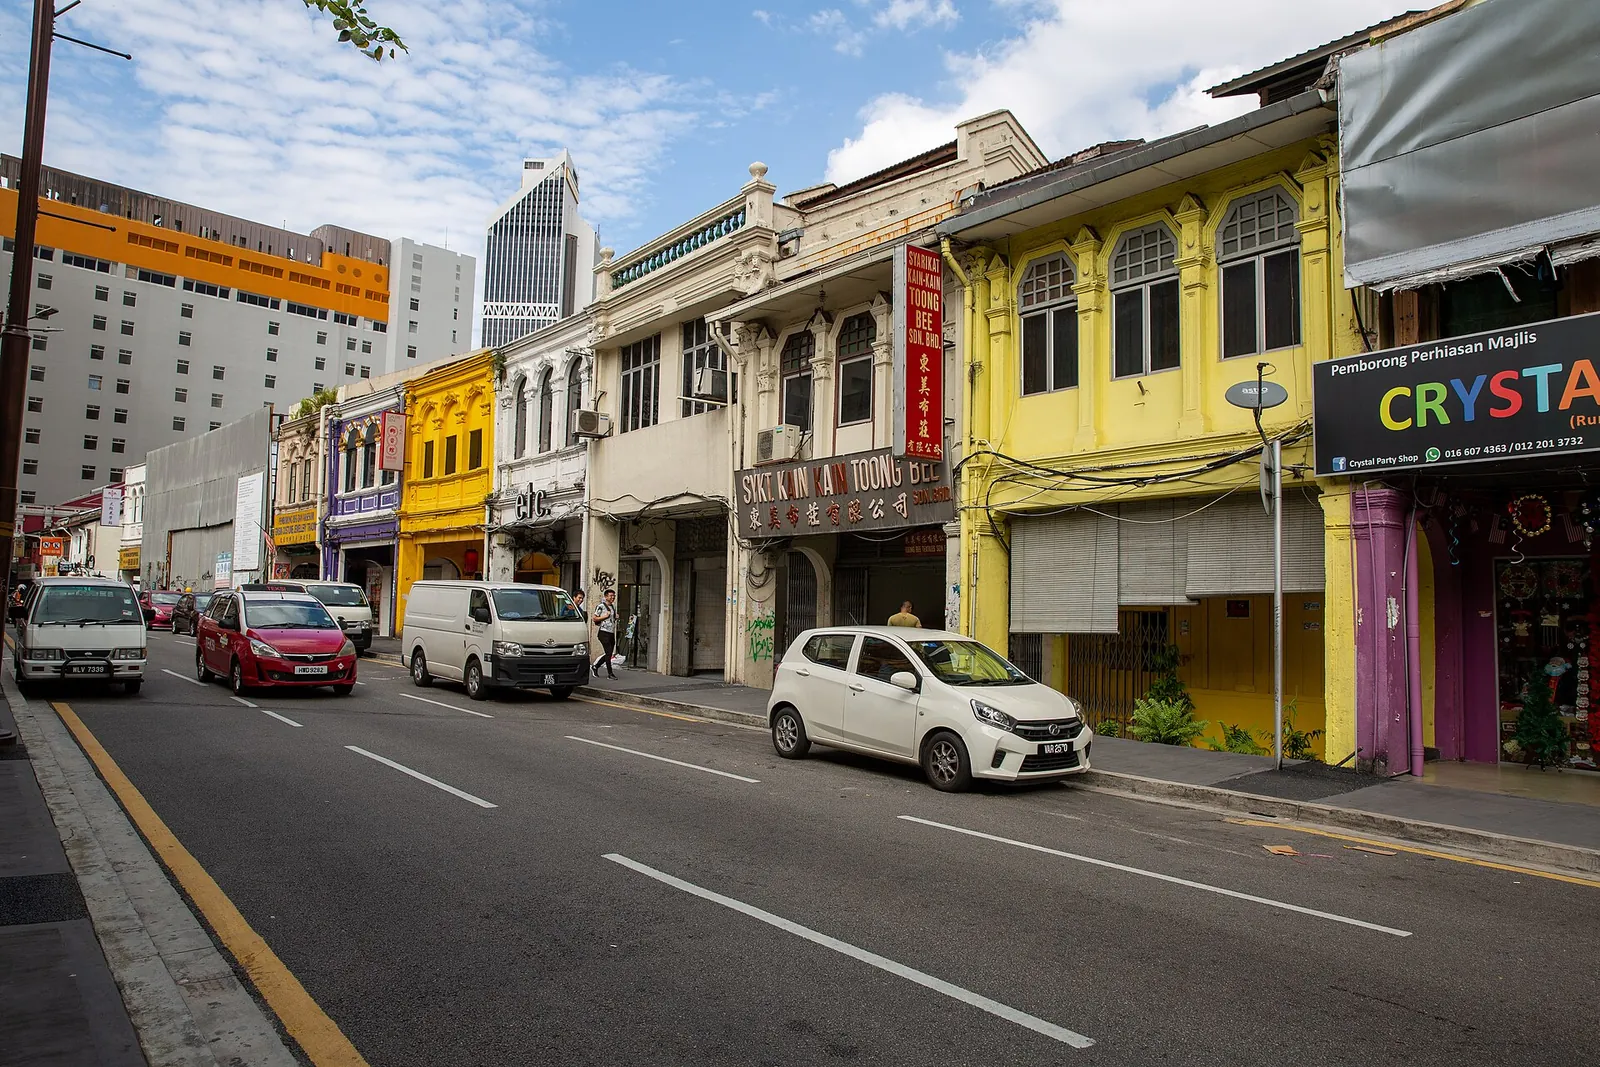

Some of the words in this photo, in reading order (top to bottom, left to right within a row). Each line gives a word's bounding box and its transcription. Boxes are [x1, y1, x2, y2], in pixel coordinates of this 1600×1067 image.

[909, 250, 940, 273] SYARIKAT
[908, 267, 941, 291] KAIN-KAIN
[909, 286, 939, 312] TOONG
[915, 310, 933, 331] BEE
[908, 328, 924, 346] SDN.
[925, 332, 941, 349] BHD.
[1331, 355, 1408, 376] Pemborong
[1411, 342, 1483, 363] Perhiasan
[1488, 331, 1537, 350] Majlis
[1241, 386, 1269, 395] asto
[1569, 414, 1600, 429] (Ru
[1444, 449, 1462, 458] 016
[1464, 447, 1481, 456] 607
[1483, 444, 1507, 454] 4363
[1535, 439, 1555, 449] 201
[1557, 436, 1584, 447] 3732
[1349, 457, 1375, 468] Crystal
[1376, 456, 1397, 466] Party
[1398, 454, 1419, 463] Shop
[742, 472, 775, 505] SYKT.
[776, 466, 810, 501] KAIN
[812, 461, 849, 498] KAIN
[850, 453, 903, 493] TOONG
[908, 460, 940, 485] BEE
[515, 482, 552, 520] etc.
